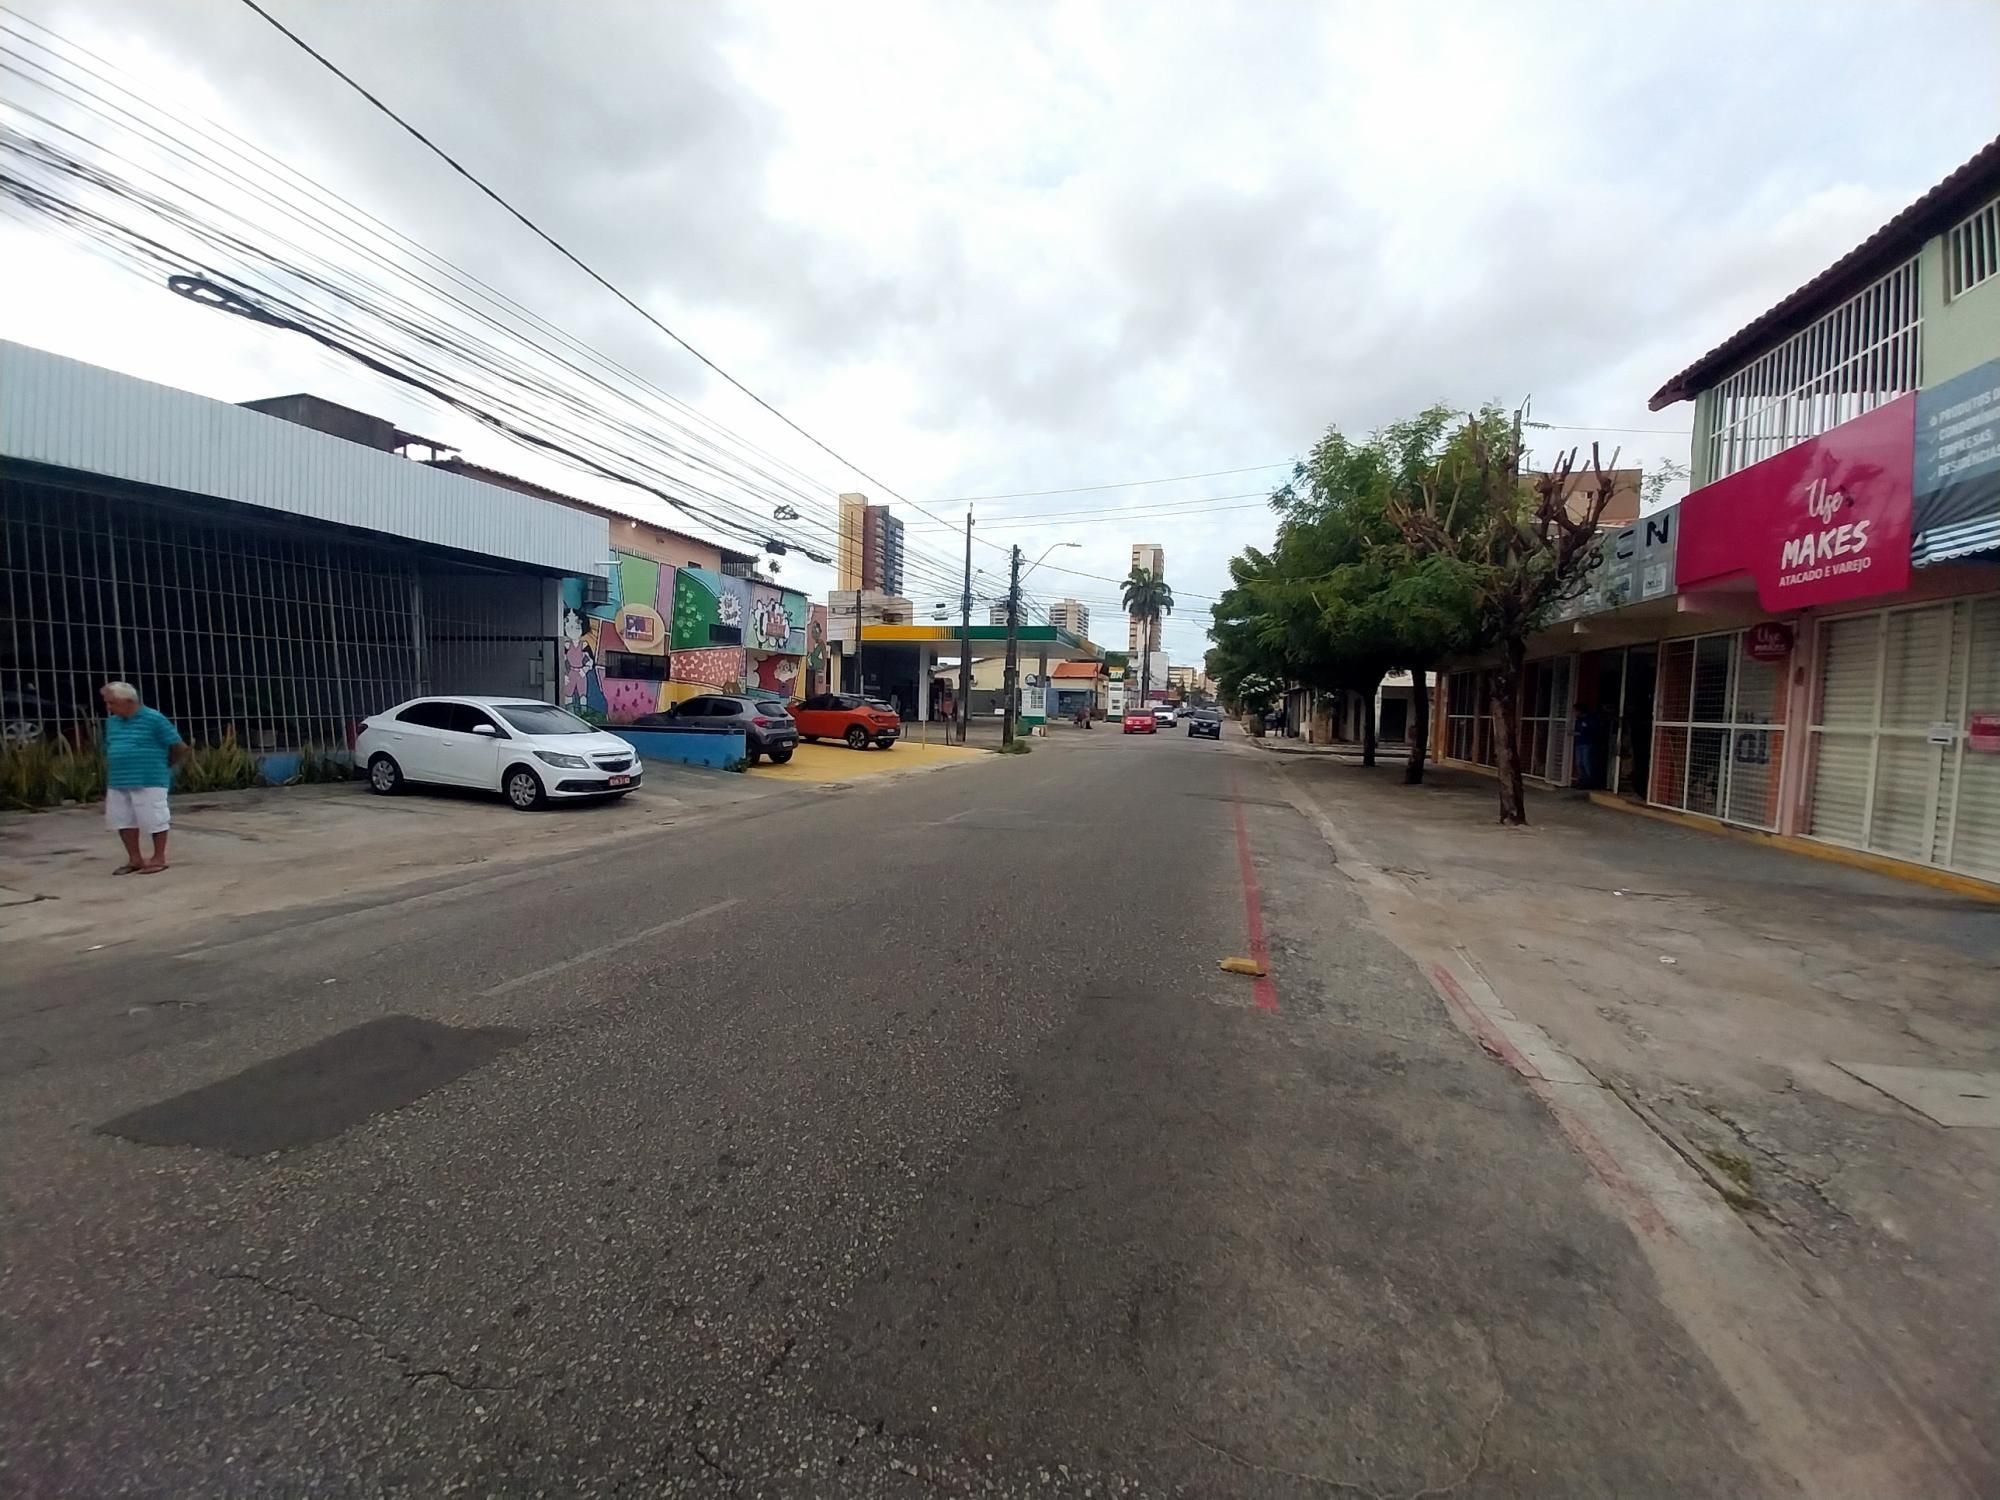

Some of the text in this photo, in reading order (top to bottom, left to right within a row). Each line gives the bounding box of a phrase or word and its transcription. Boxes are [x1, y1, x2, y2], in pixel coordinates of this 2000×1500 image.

[1805, 478, 1843, 525] Use
[1781, 520, 1871, 570] MAKES
[1779, 557, 1872, 587] ATACADO E VAREJO
